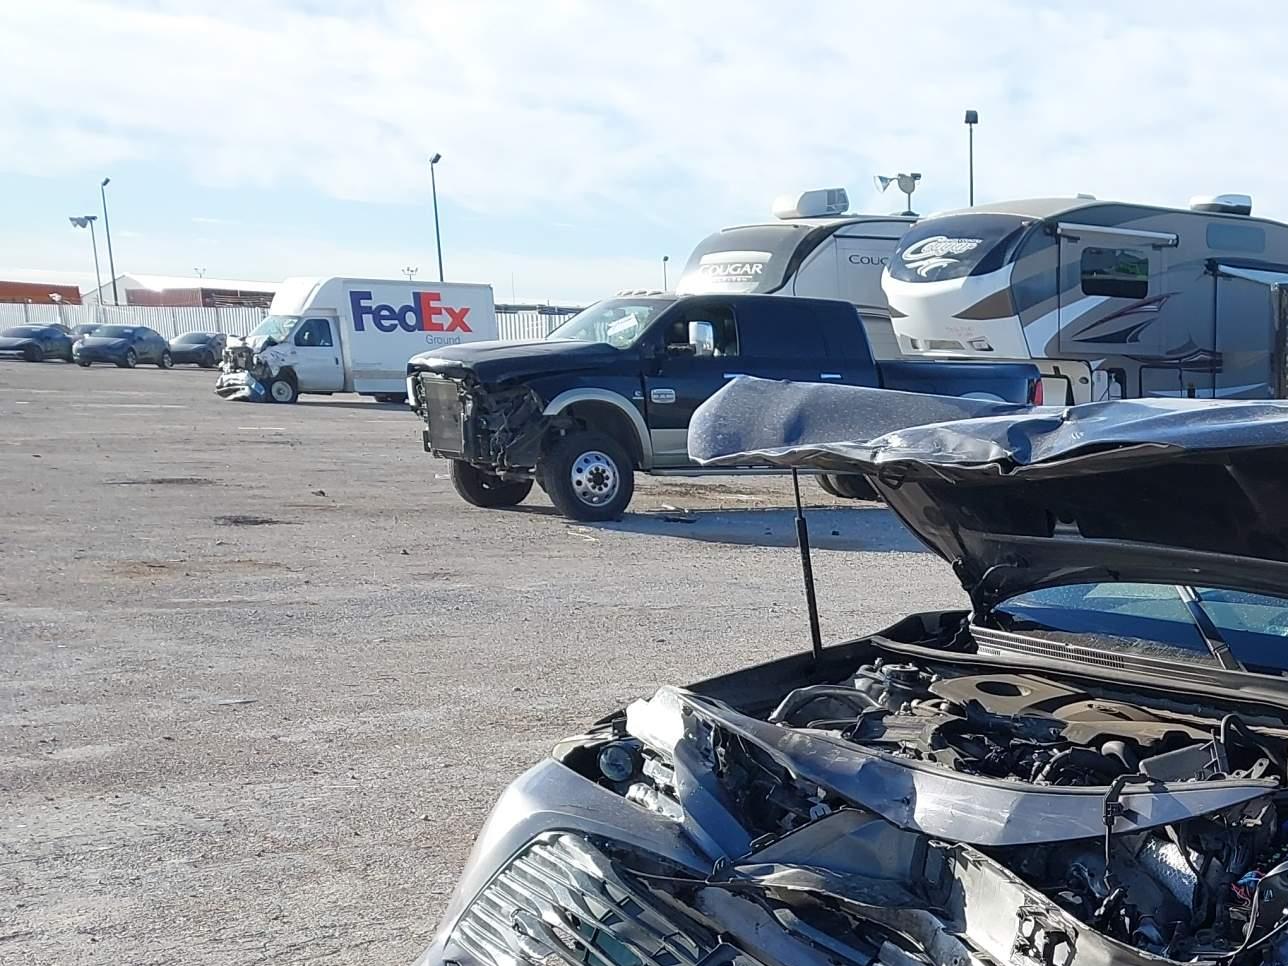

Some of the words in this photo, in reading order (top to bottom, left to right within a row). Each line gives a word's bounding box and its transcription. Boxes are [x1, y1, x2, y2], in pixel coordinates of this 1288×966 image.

[700, 263, 763, 275] COUGAR
[349, 290, 473, 333] FedEx
[425, 335, 461, 345] Ground
